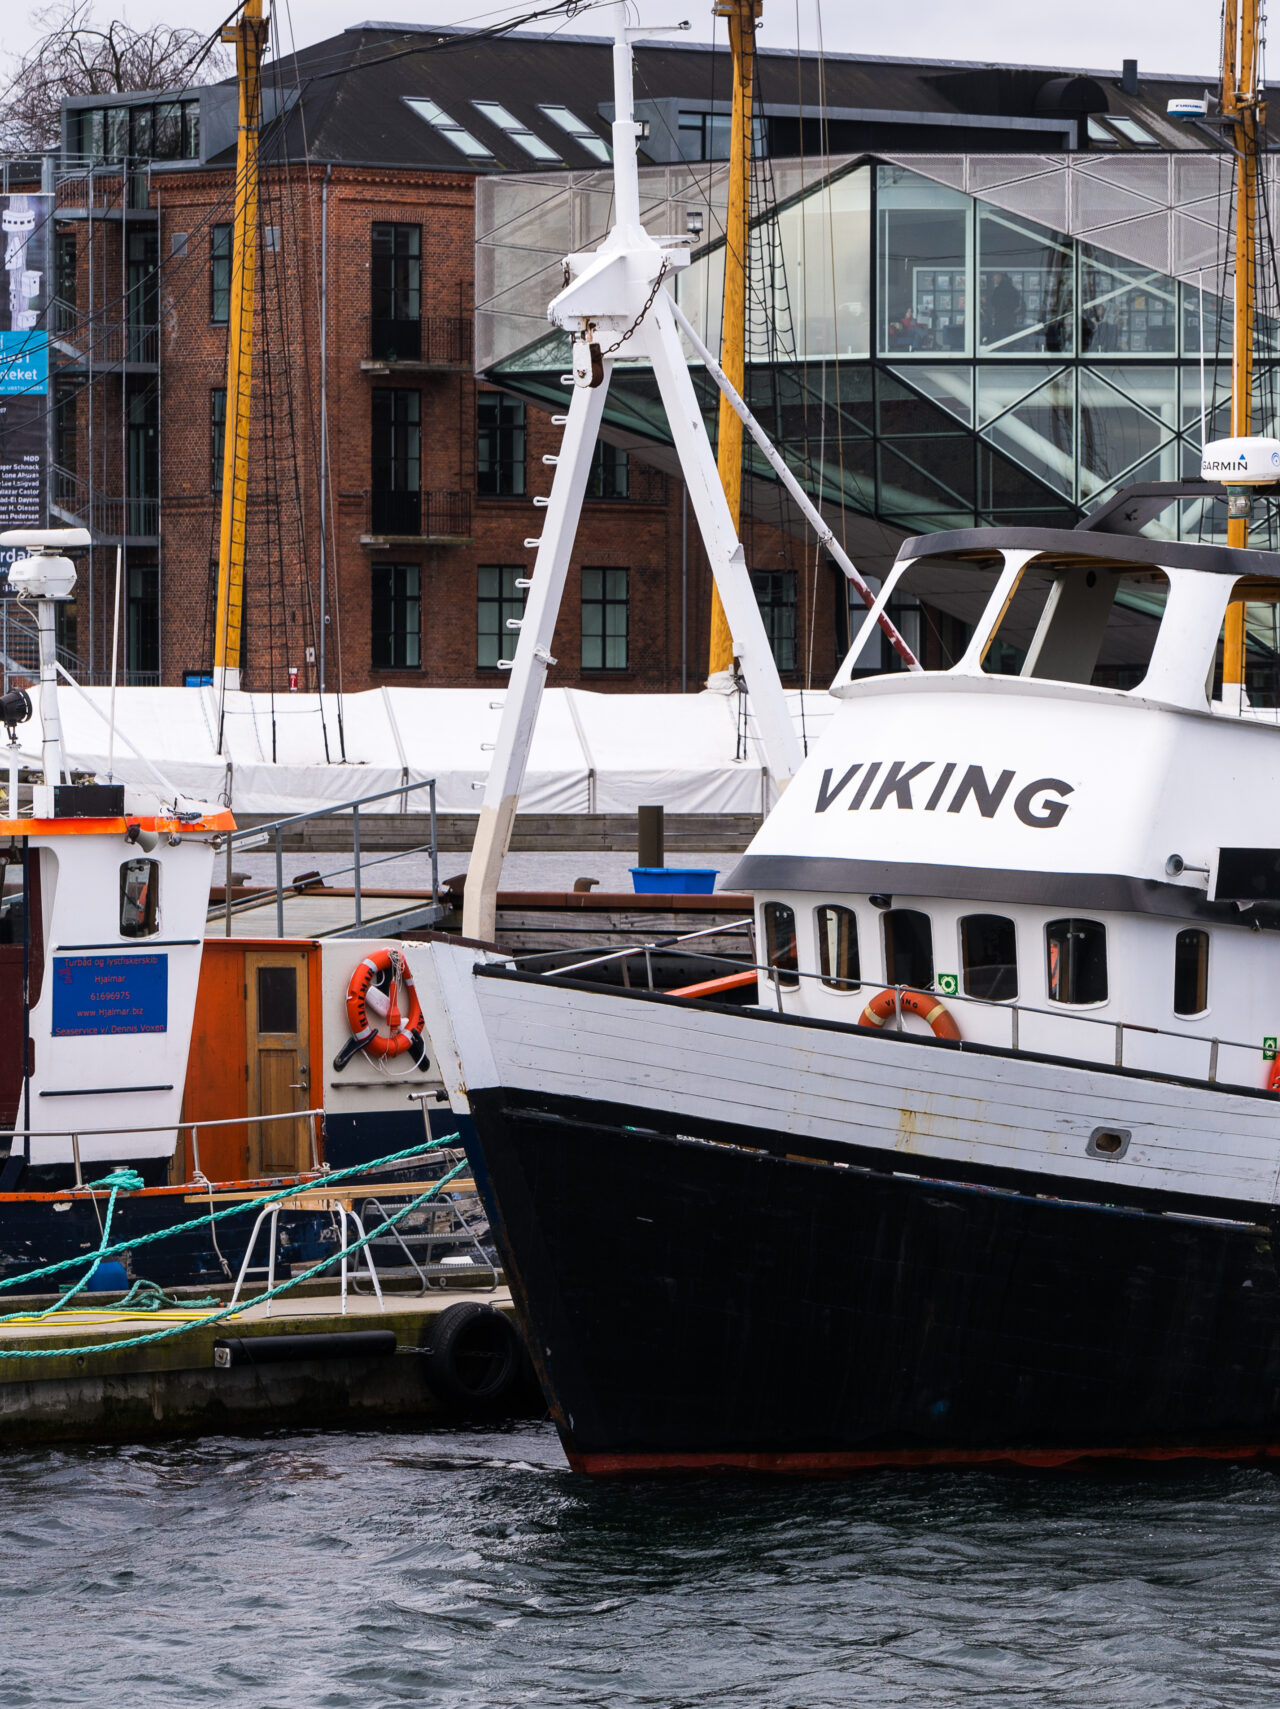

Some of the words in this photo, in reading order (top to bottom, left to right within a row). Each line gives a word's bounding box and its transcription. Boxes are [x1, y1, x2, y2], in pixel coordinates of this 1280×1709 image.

[1202, 460, 1248, 471] GARMIN
[815, 761, 1075, 829] VIKING
[64, 956, 92, 967] Turbåd
[95, 959, 104, 967] og
[94, 974, 126, 985] Hjalmar
[90, 991, 131, 1001] 61696975
[885, 998, 918, 1009] VIING
[55, 1026, 98, 1036] Seaservice
[111, 1024, 138, 1034] Dennis
[140, 1023, 165, 1032] Voxen
